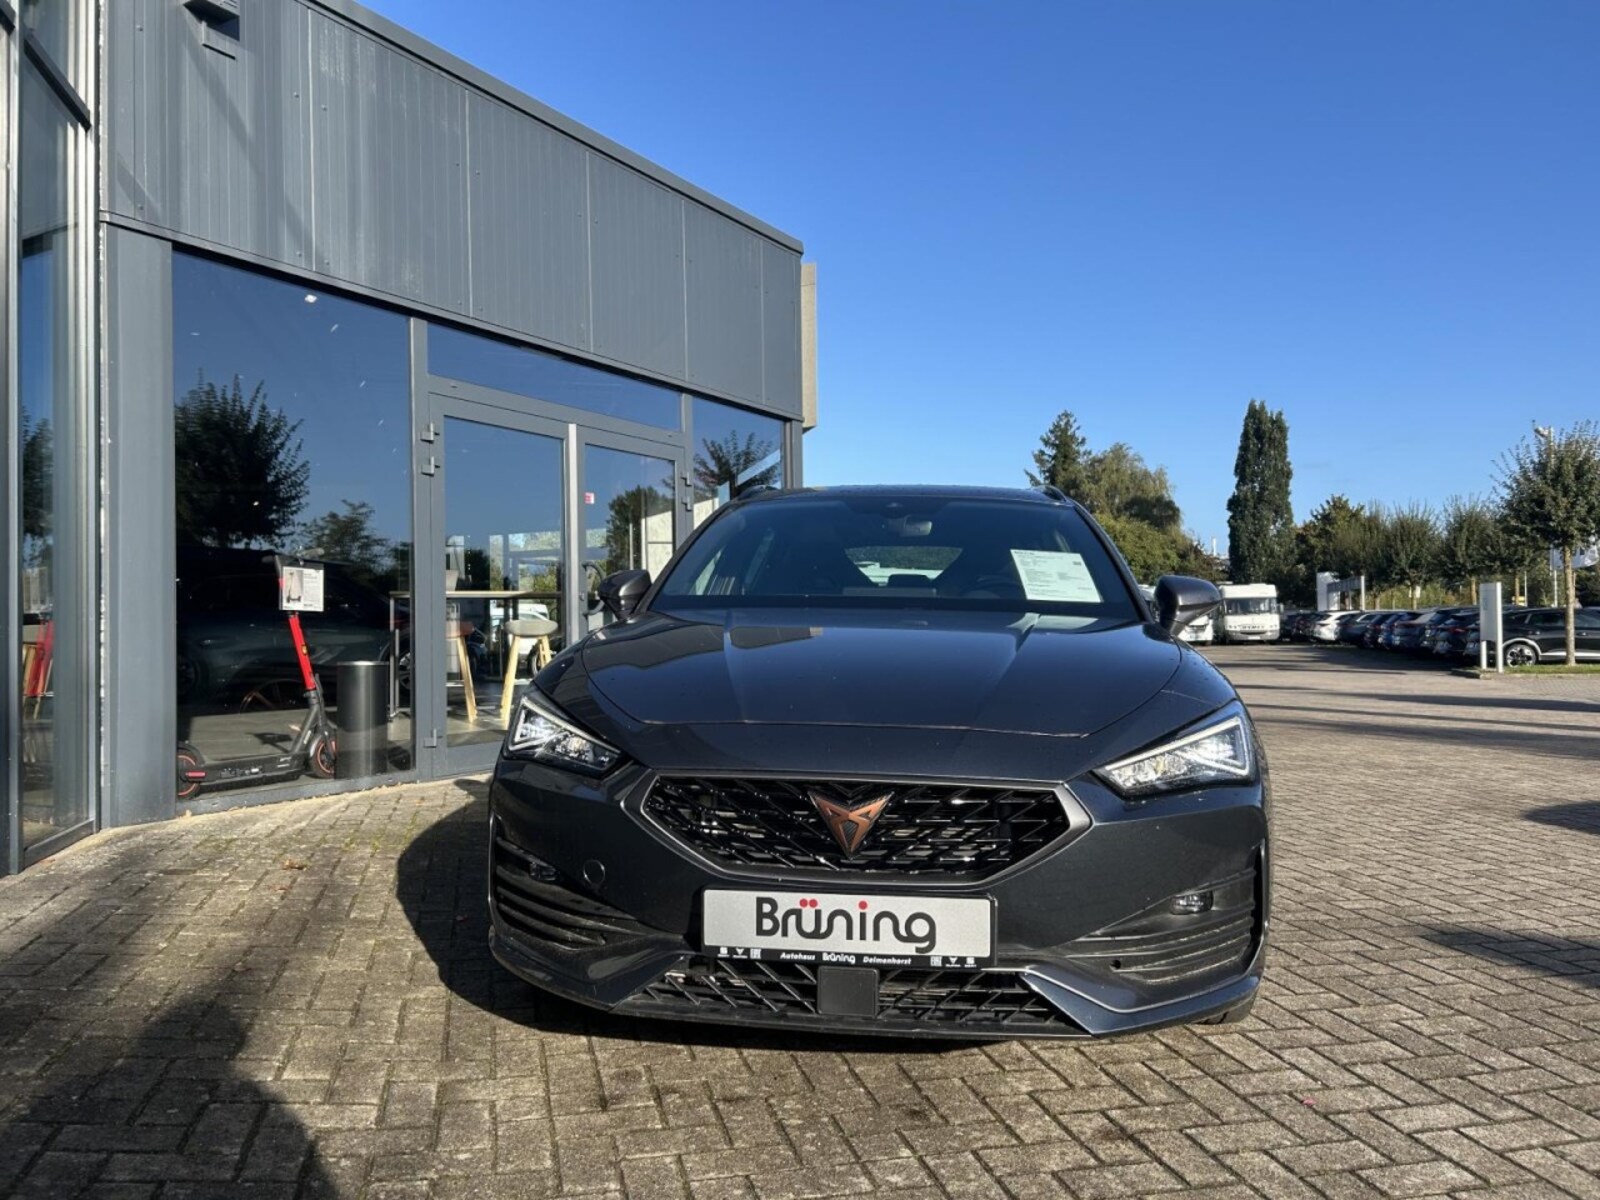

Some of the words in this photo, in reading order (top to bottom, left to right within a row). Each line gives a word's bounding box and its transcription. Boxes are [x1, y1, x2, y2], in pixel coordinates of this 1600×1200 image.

[755, 896, 937, 954] Brüning
[779, 952, 816, 961] Autohaus
[821, 953, 856, 965] Brüning
[862, 956, 912, 965] Delmenhorst
